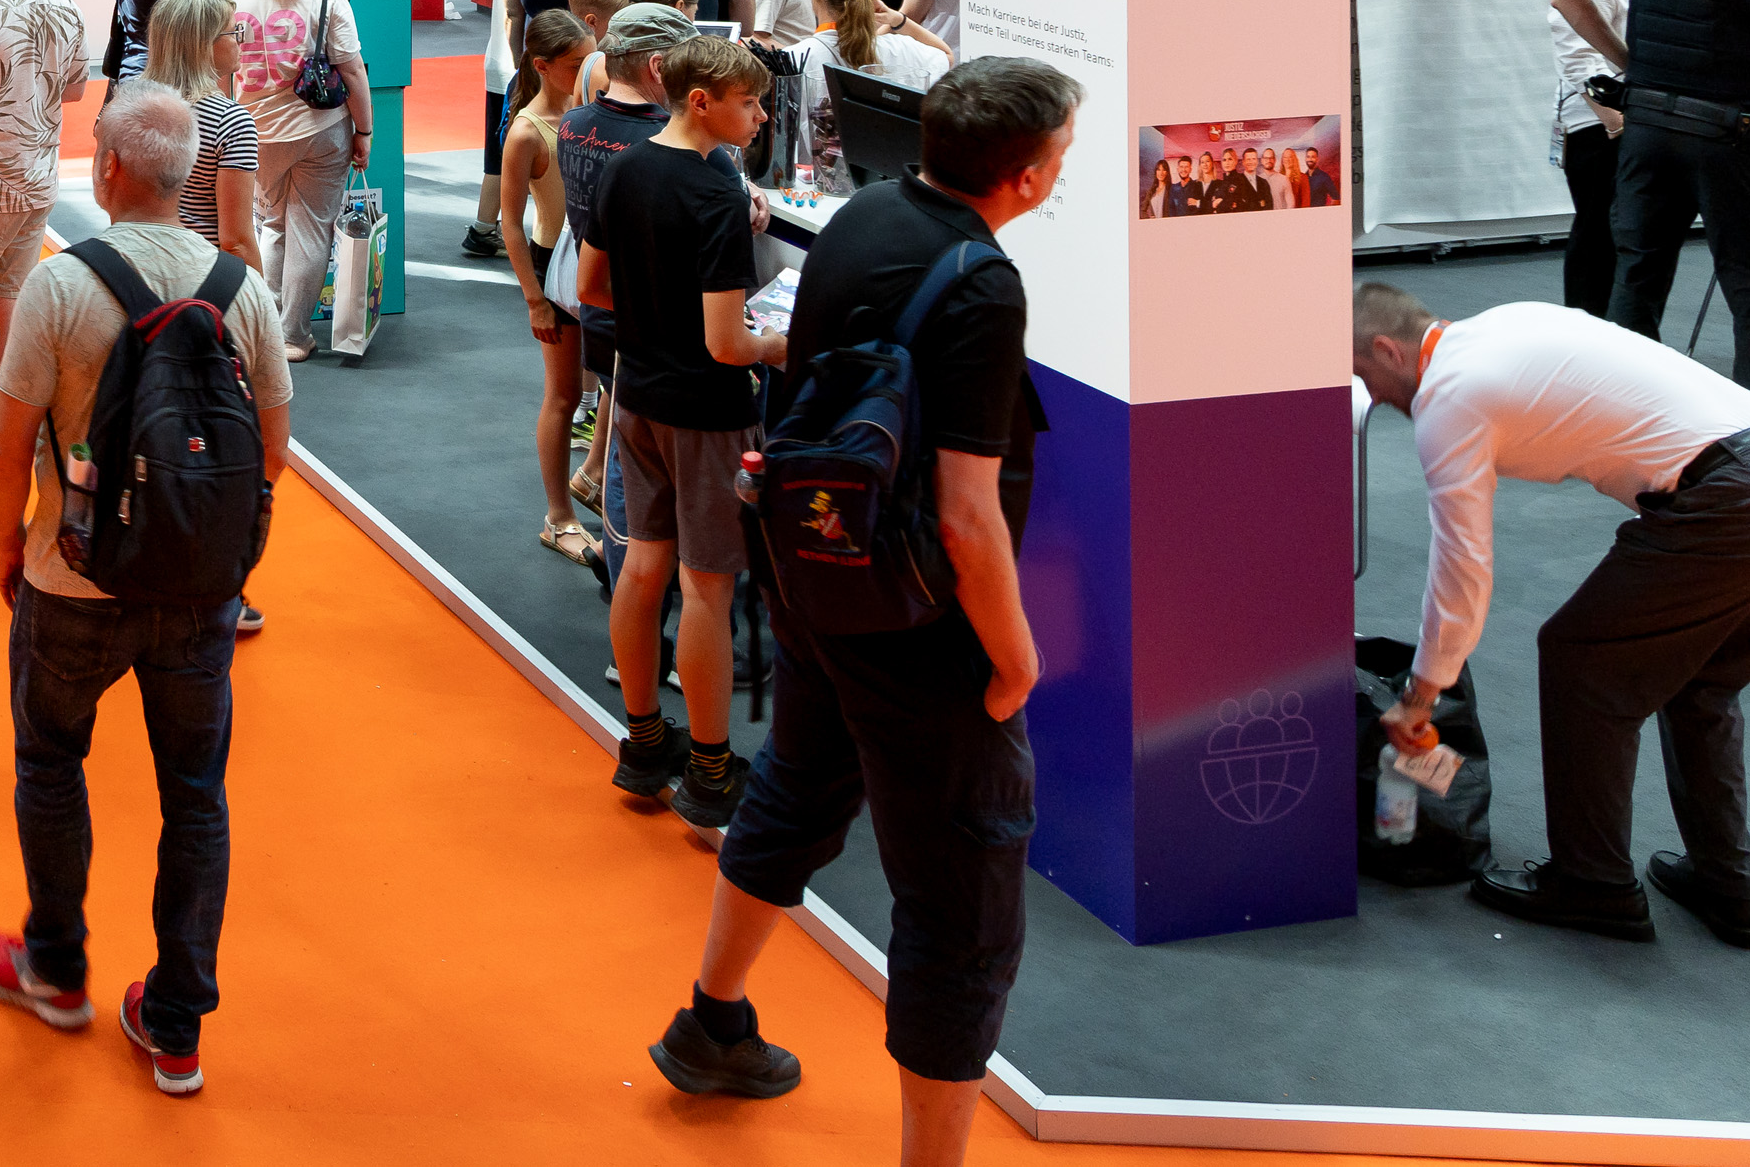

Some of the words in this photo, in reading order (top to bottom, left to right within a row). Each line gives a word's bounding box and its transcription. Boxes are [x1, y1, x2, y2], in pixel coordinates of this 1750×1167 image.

[968, 2, 990, 17] Mach
[993, 8, 1026, 26] Karriere
[1028, 16, 1041, 29] bei
[1044, 20, 1058, 33] der
[1061, 24, 1088, 43] Justiz,
[968, 22, 993, 36] werde
[996, 27, 1010, 40] Teil
[1012, 33, 1045, 50] unseres
[1047, 41, 1079, 58] starken
[1082, 49, 1114, 68] Teams:
[1224, 122, 1244, 132] JUSTIZ
[1224, 130, 1272, 141] NIEDERSACHSEN
[564, 142, 611, 162] HIGHWAY
[559, 153, 594, 182] AMP
